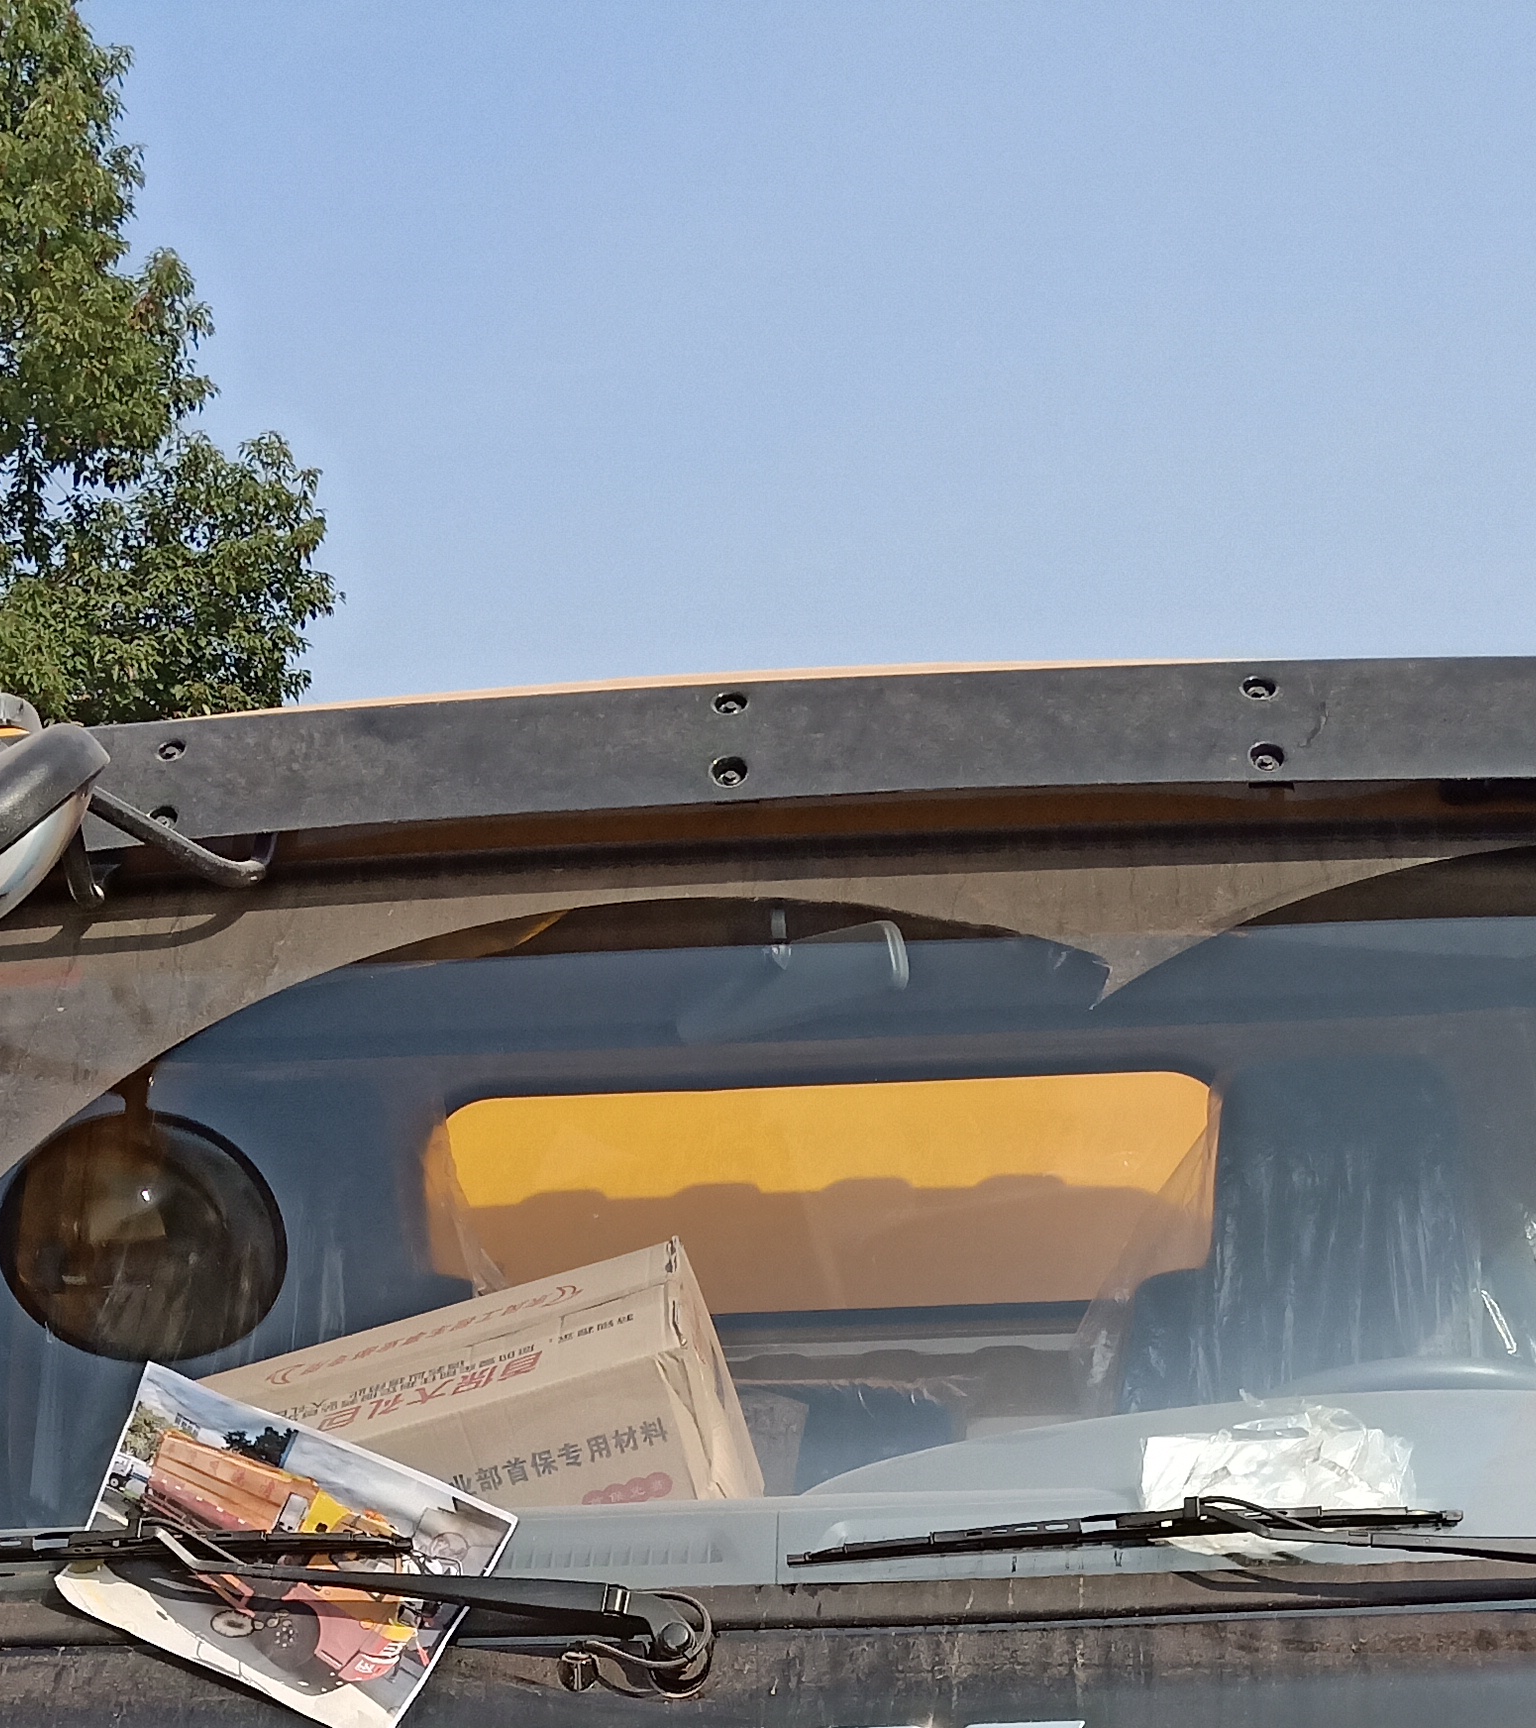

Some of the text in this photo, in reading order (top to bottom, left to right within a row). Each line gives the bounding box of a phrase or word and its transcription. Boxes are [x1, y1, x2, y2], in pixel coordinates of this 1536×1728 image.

[316, 1349, 544, 1432] 首保大礼包
